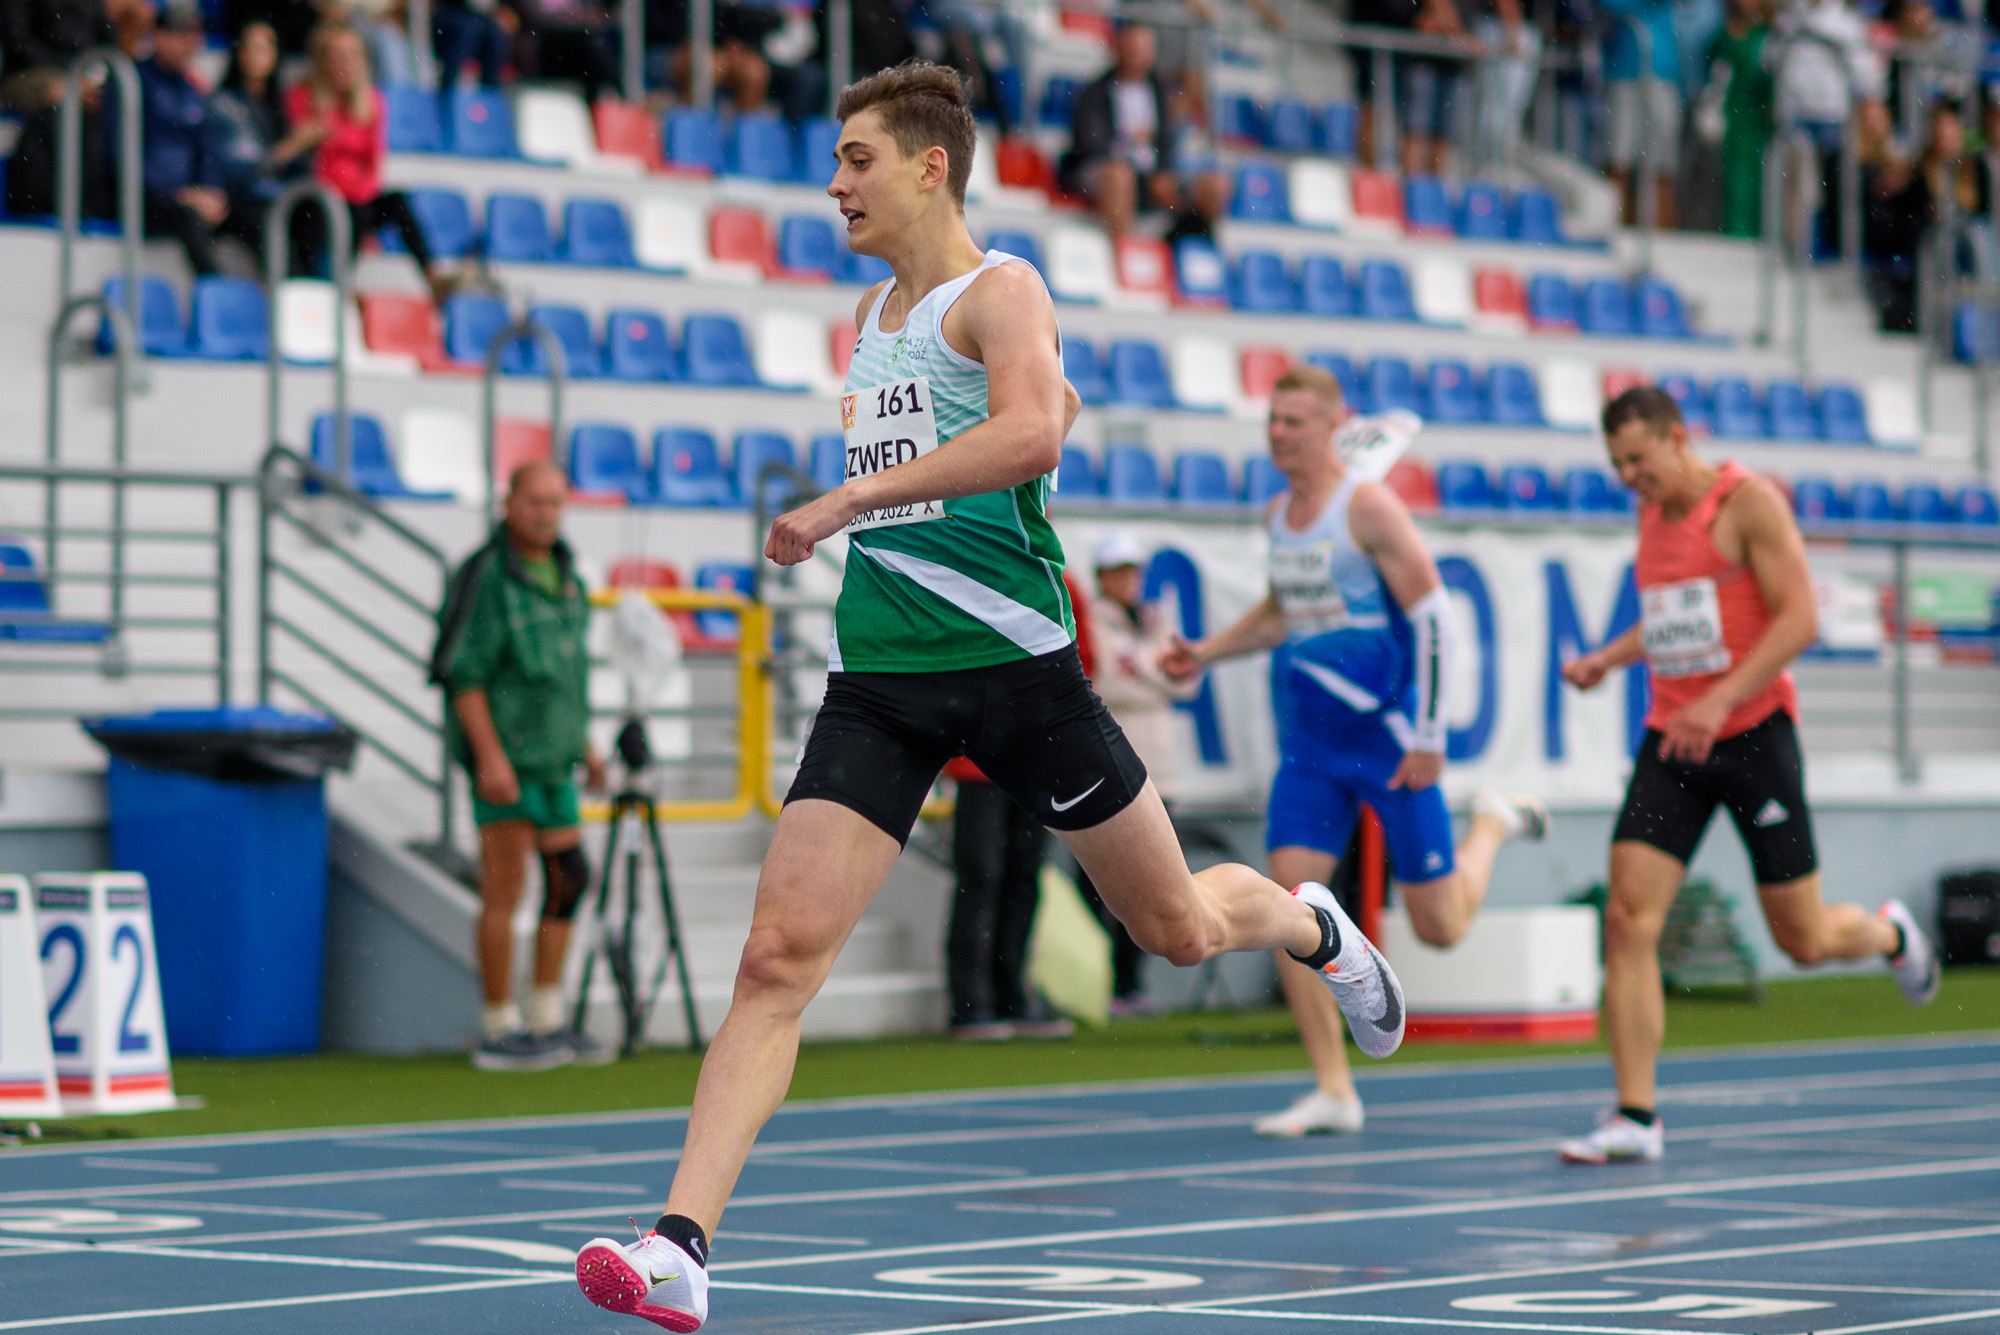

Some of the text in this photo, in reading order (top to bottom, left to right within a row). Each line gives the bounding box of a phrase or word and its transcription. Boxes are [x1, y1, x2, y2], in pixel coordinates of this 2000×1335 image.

[876, 382, 924, 419] 161
[845, 438, 918, 480] ZWED
[847, 503, 914, 527] DOM 2022
[39, 923, 86, 1053] 2
[110, 923, 149, 1052] 2
[1450, 1291, 1838, 1320] 5
